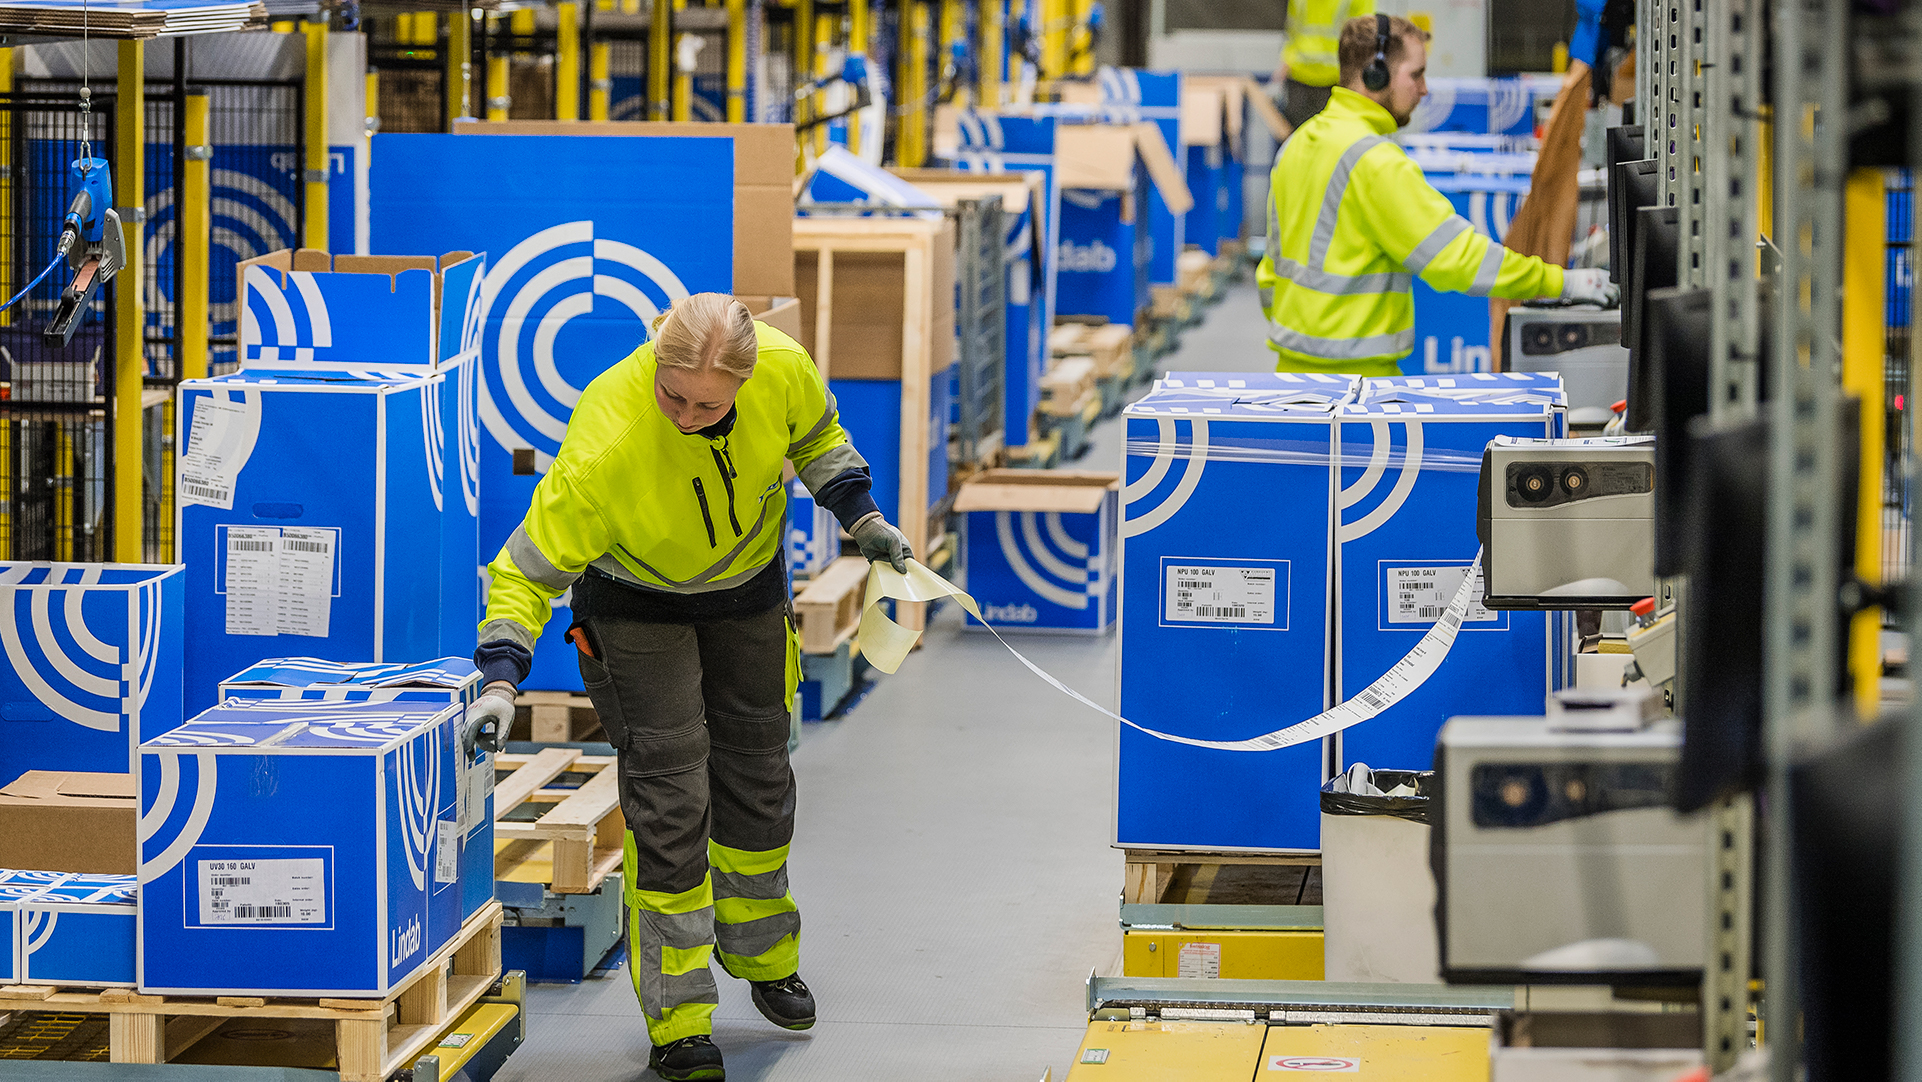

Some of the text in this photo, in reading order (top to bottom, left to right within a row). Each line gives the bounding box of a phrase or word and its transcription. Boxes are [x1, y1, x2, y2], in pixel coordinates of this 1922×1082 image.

[210, 862, 256, 870] UV30 160 GALV
[392, 913, 421, 969] Lindab
